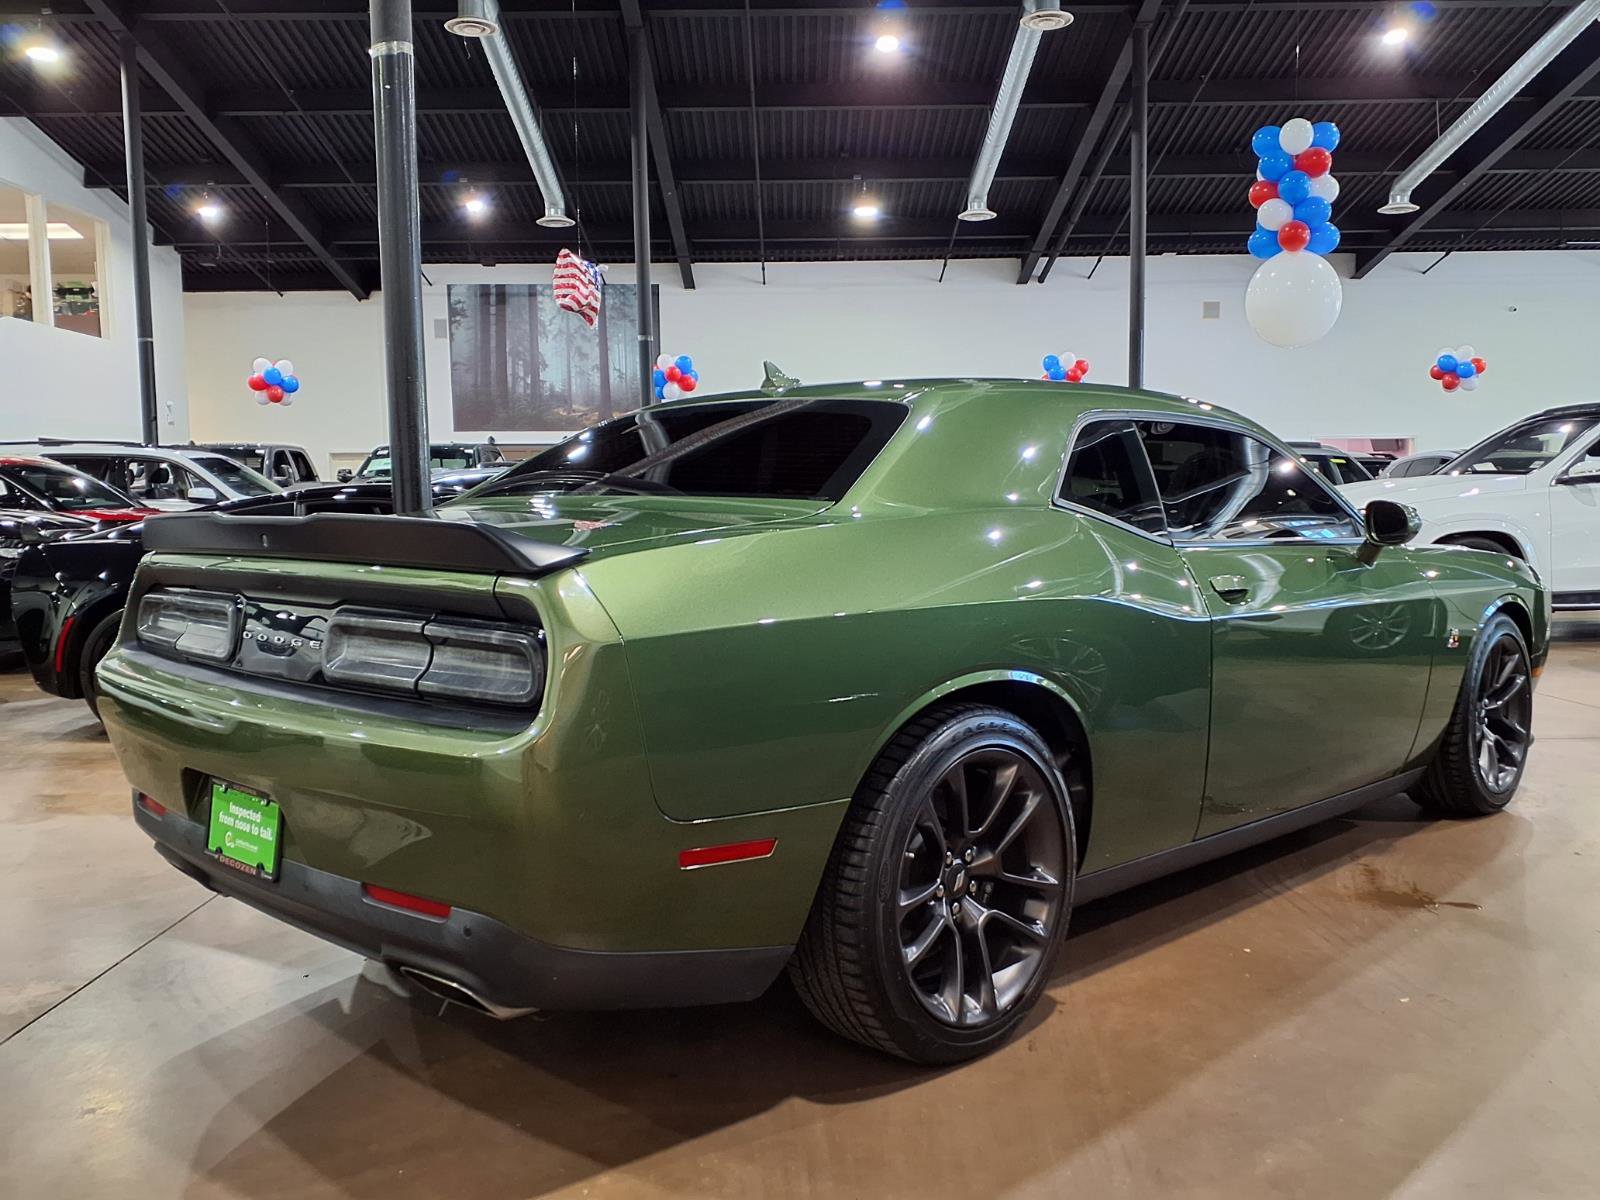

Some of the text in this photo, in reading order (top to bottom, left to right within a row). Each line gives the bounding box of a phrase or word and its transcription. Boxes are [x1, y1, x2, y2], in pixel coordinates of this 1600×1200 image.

[243, 631, 321, 649] DODGE
[230, 802, 262, 822] Inspected
[219, 811, 234, 827] from
[235, 820, 250, 832] nose
[251, 823, 259, 836] to
[219, 855, 257, 875] DECOZEN
